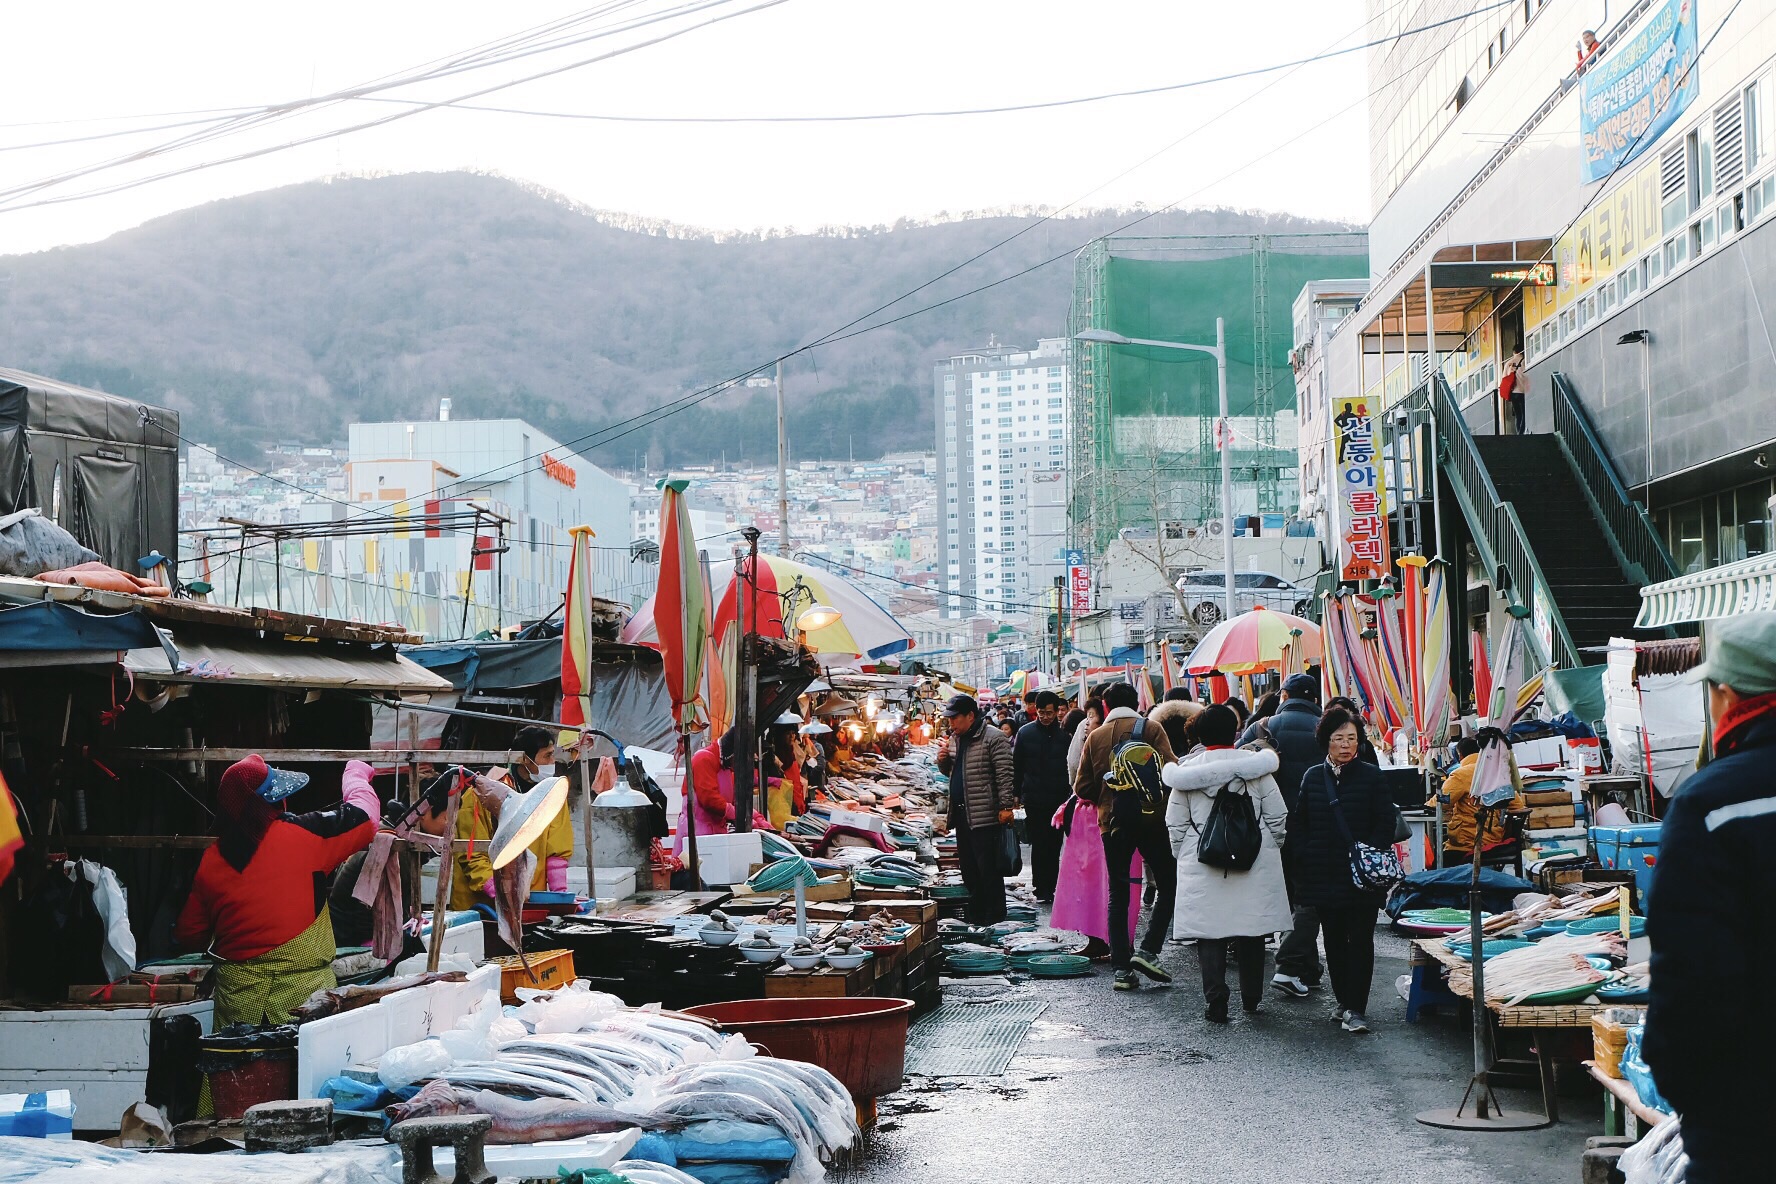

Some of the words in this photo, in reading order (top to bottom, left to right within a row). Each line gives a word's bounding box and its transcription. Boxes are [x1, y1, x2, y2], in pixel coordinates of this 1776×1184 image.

[1345, 417, 1377, 487] 신동아
[1349, 490, 1384, 564] 콜라텍
[1349, 565, 1370, 576] 지하
